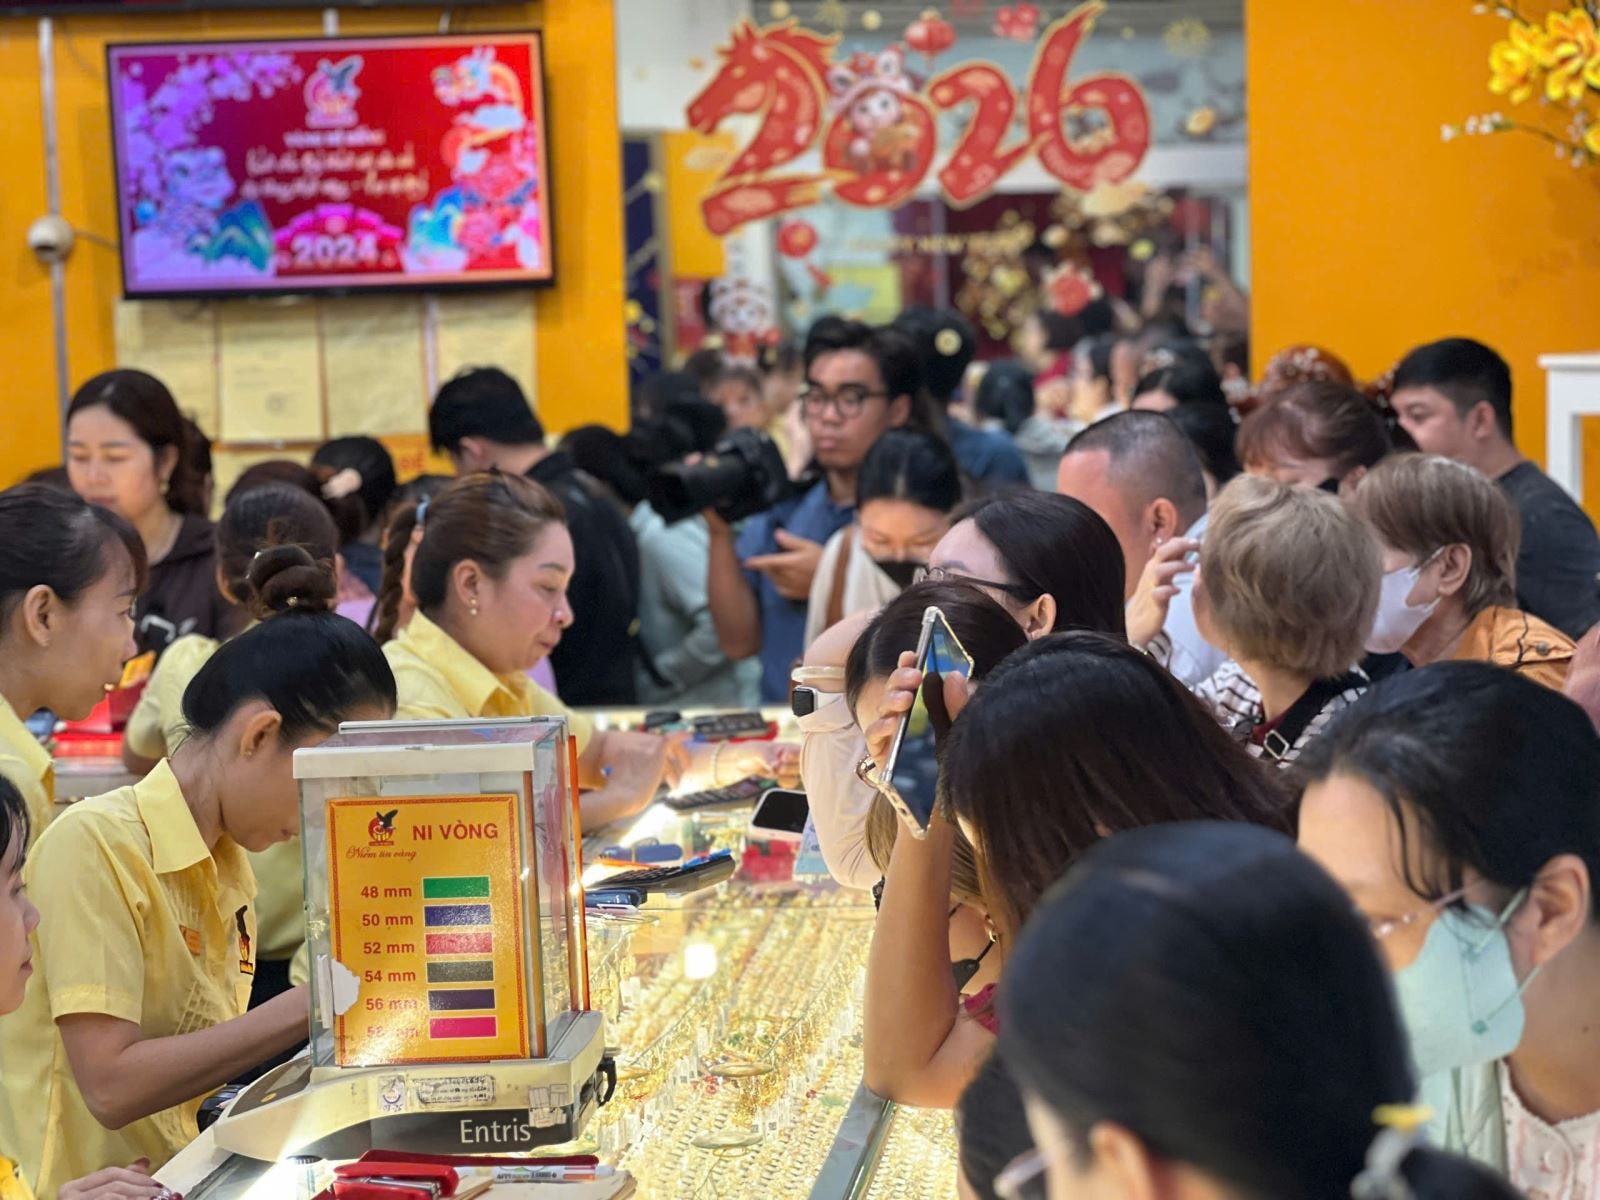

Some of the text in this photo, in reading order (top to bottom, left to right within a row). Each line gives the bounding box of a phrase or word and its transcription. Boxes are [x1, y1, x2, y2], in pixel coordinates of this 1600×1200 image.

[686, 2, 1152, 236] 2026
[291, 234, 378, 264] 2024
[412, 819, 499, 841] NI VÒNG
[361, 886, 412, 898] 48 mm
[362, 913, 414, 927] 50 mm
[363, 941, 415, 954] 52 mm
[364, 969, 416, 983] 54 mm
[366, 998, 418, 1011] 56 mm
[460, 1117, 532, 1144] Entris
